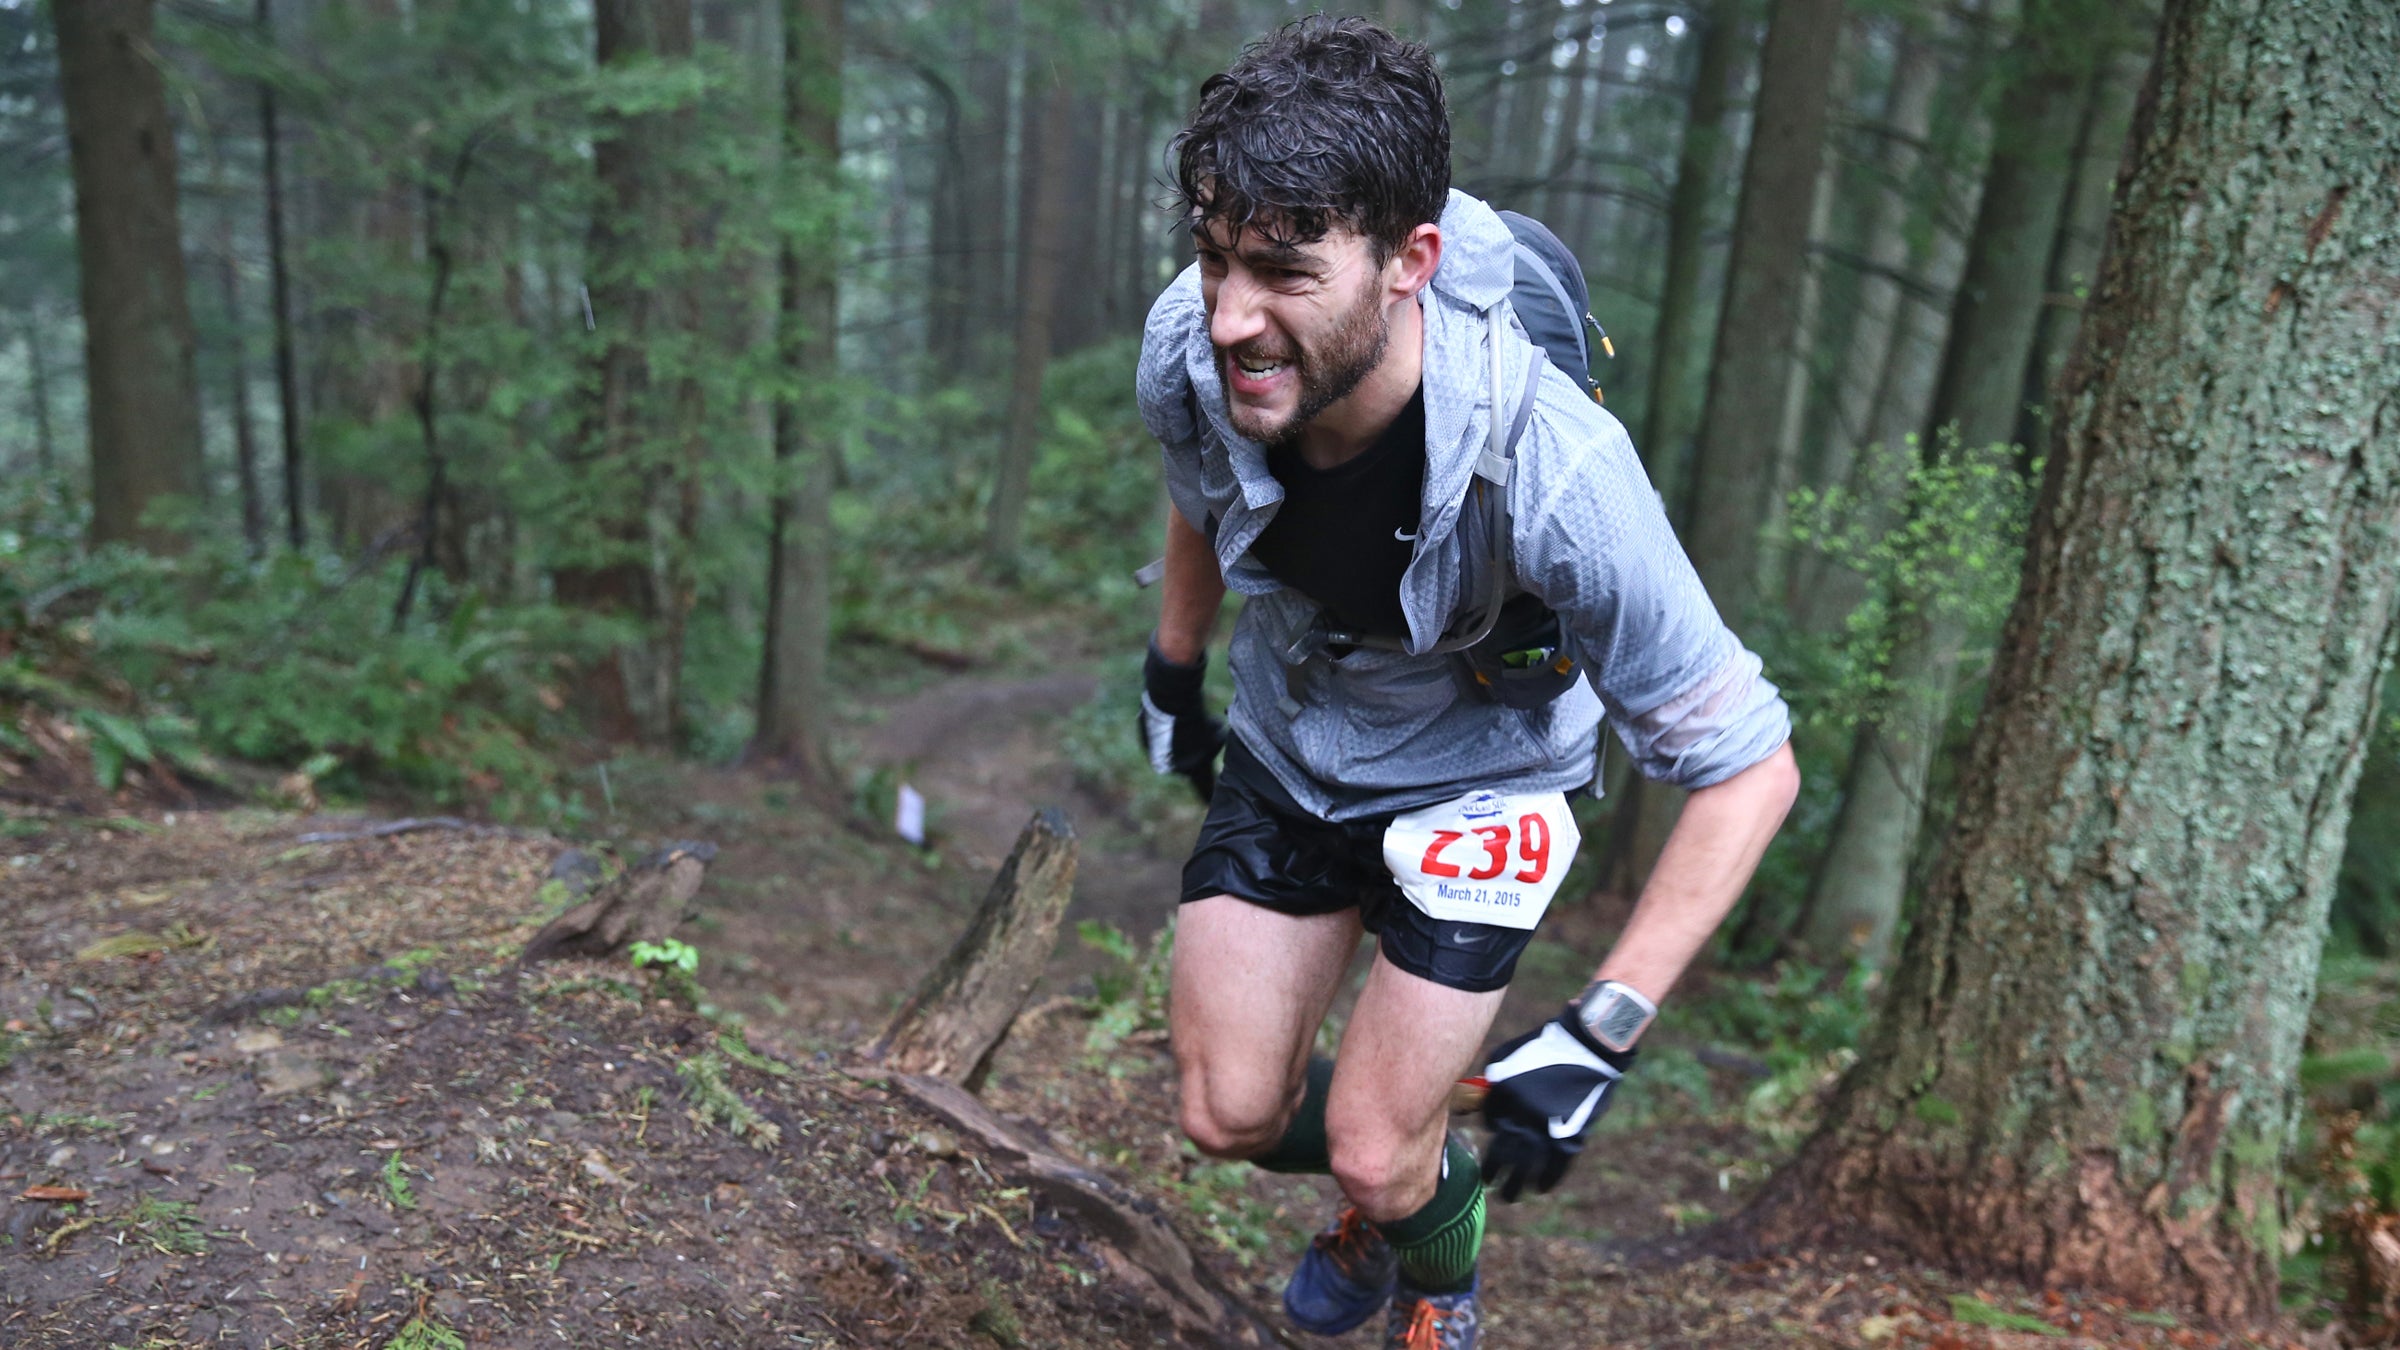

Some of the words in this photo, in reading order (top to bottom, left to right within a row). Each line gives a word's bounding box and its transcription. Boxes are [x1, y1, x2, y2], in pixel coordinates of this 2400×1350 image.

[1420, 812, 1550, 884] 239
[1437, 884, 1471, 901] March
[1474, 889, 1491, 906] 21,
[1494, 891, 1521, 907] 2015
